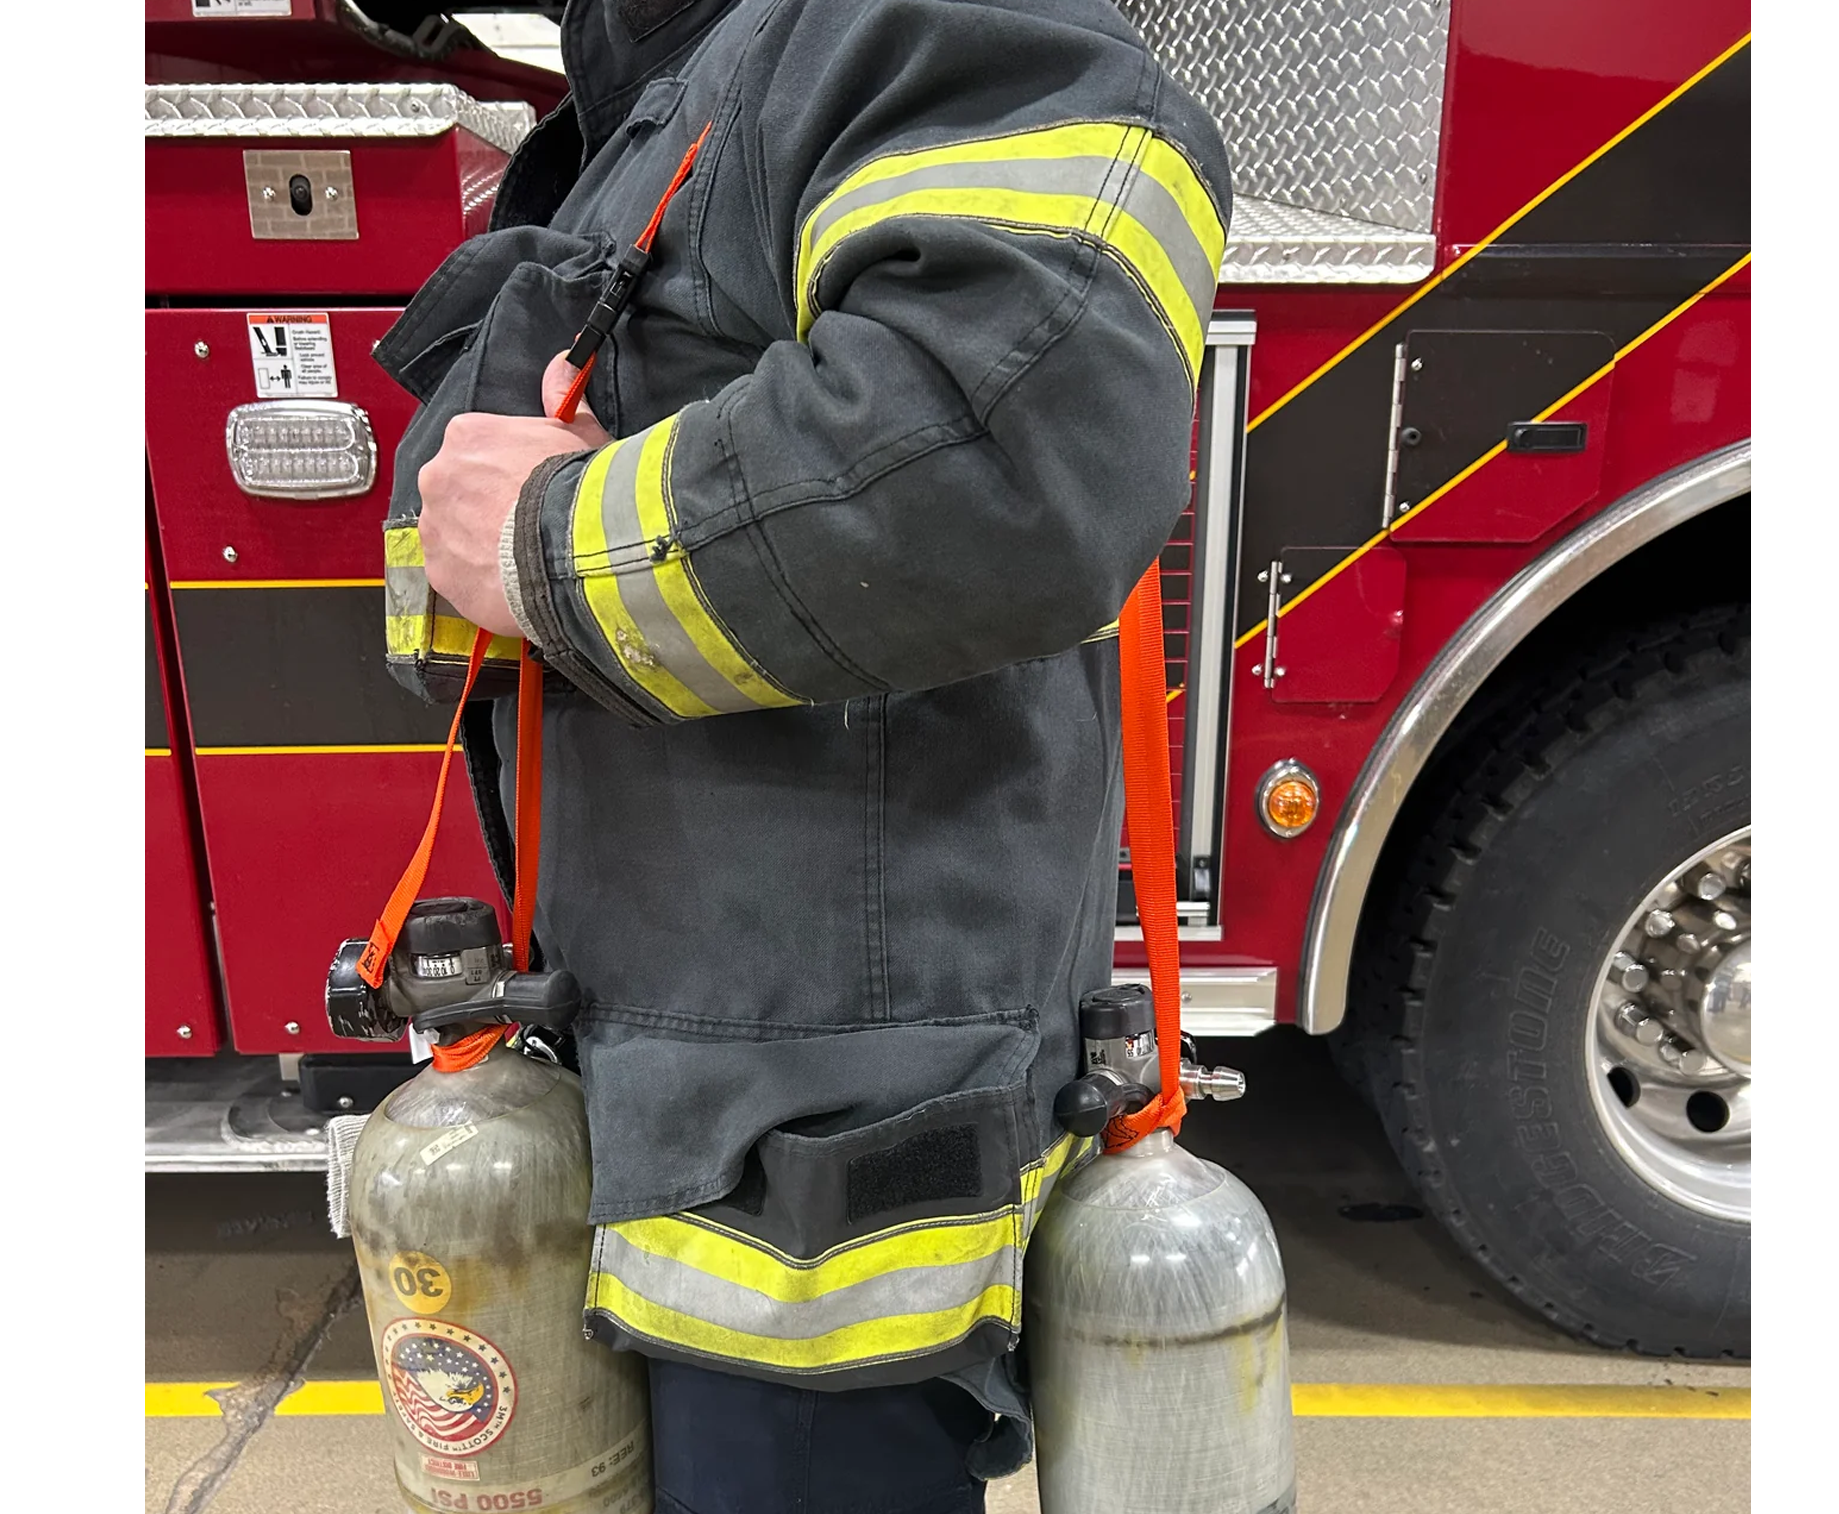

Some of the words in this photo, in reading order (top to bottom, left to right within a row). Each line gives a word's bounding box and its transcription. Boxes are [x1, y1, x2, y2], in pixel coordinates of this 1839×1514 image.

[274, 315, 312, 323] WARNING
[1507, 926, 1697, 1288] BRIDGESTONE
[394, 1267, 443, 1297] 30
[427, 1437, 449, 1451] FIRE
[591, 1462, 606, 1477] 93
[431, 1487, 469, 1510] PSI
[476, 1488, 543, 1511] 5500
